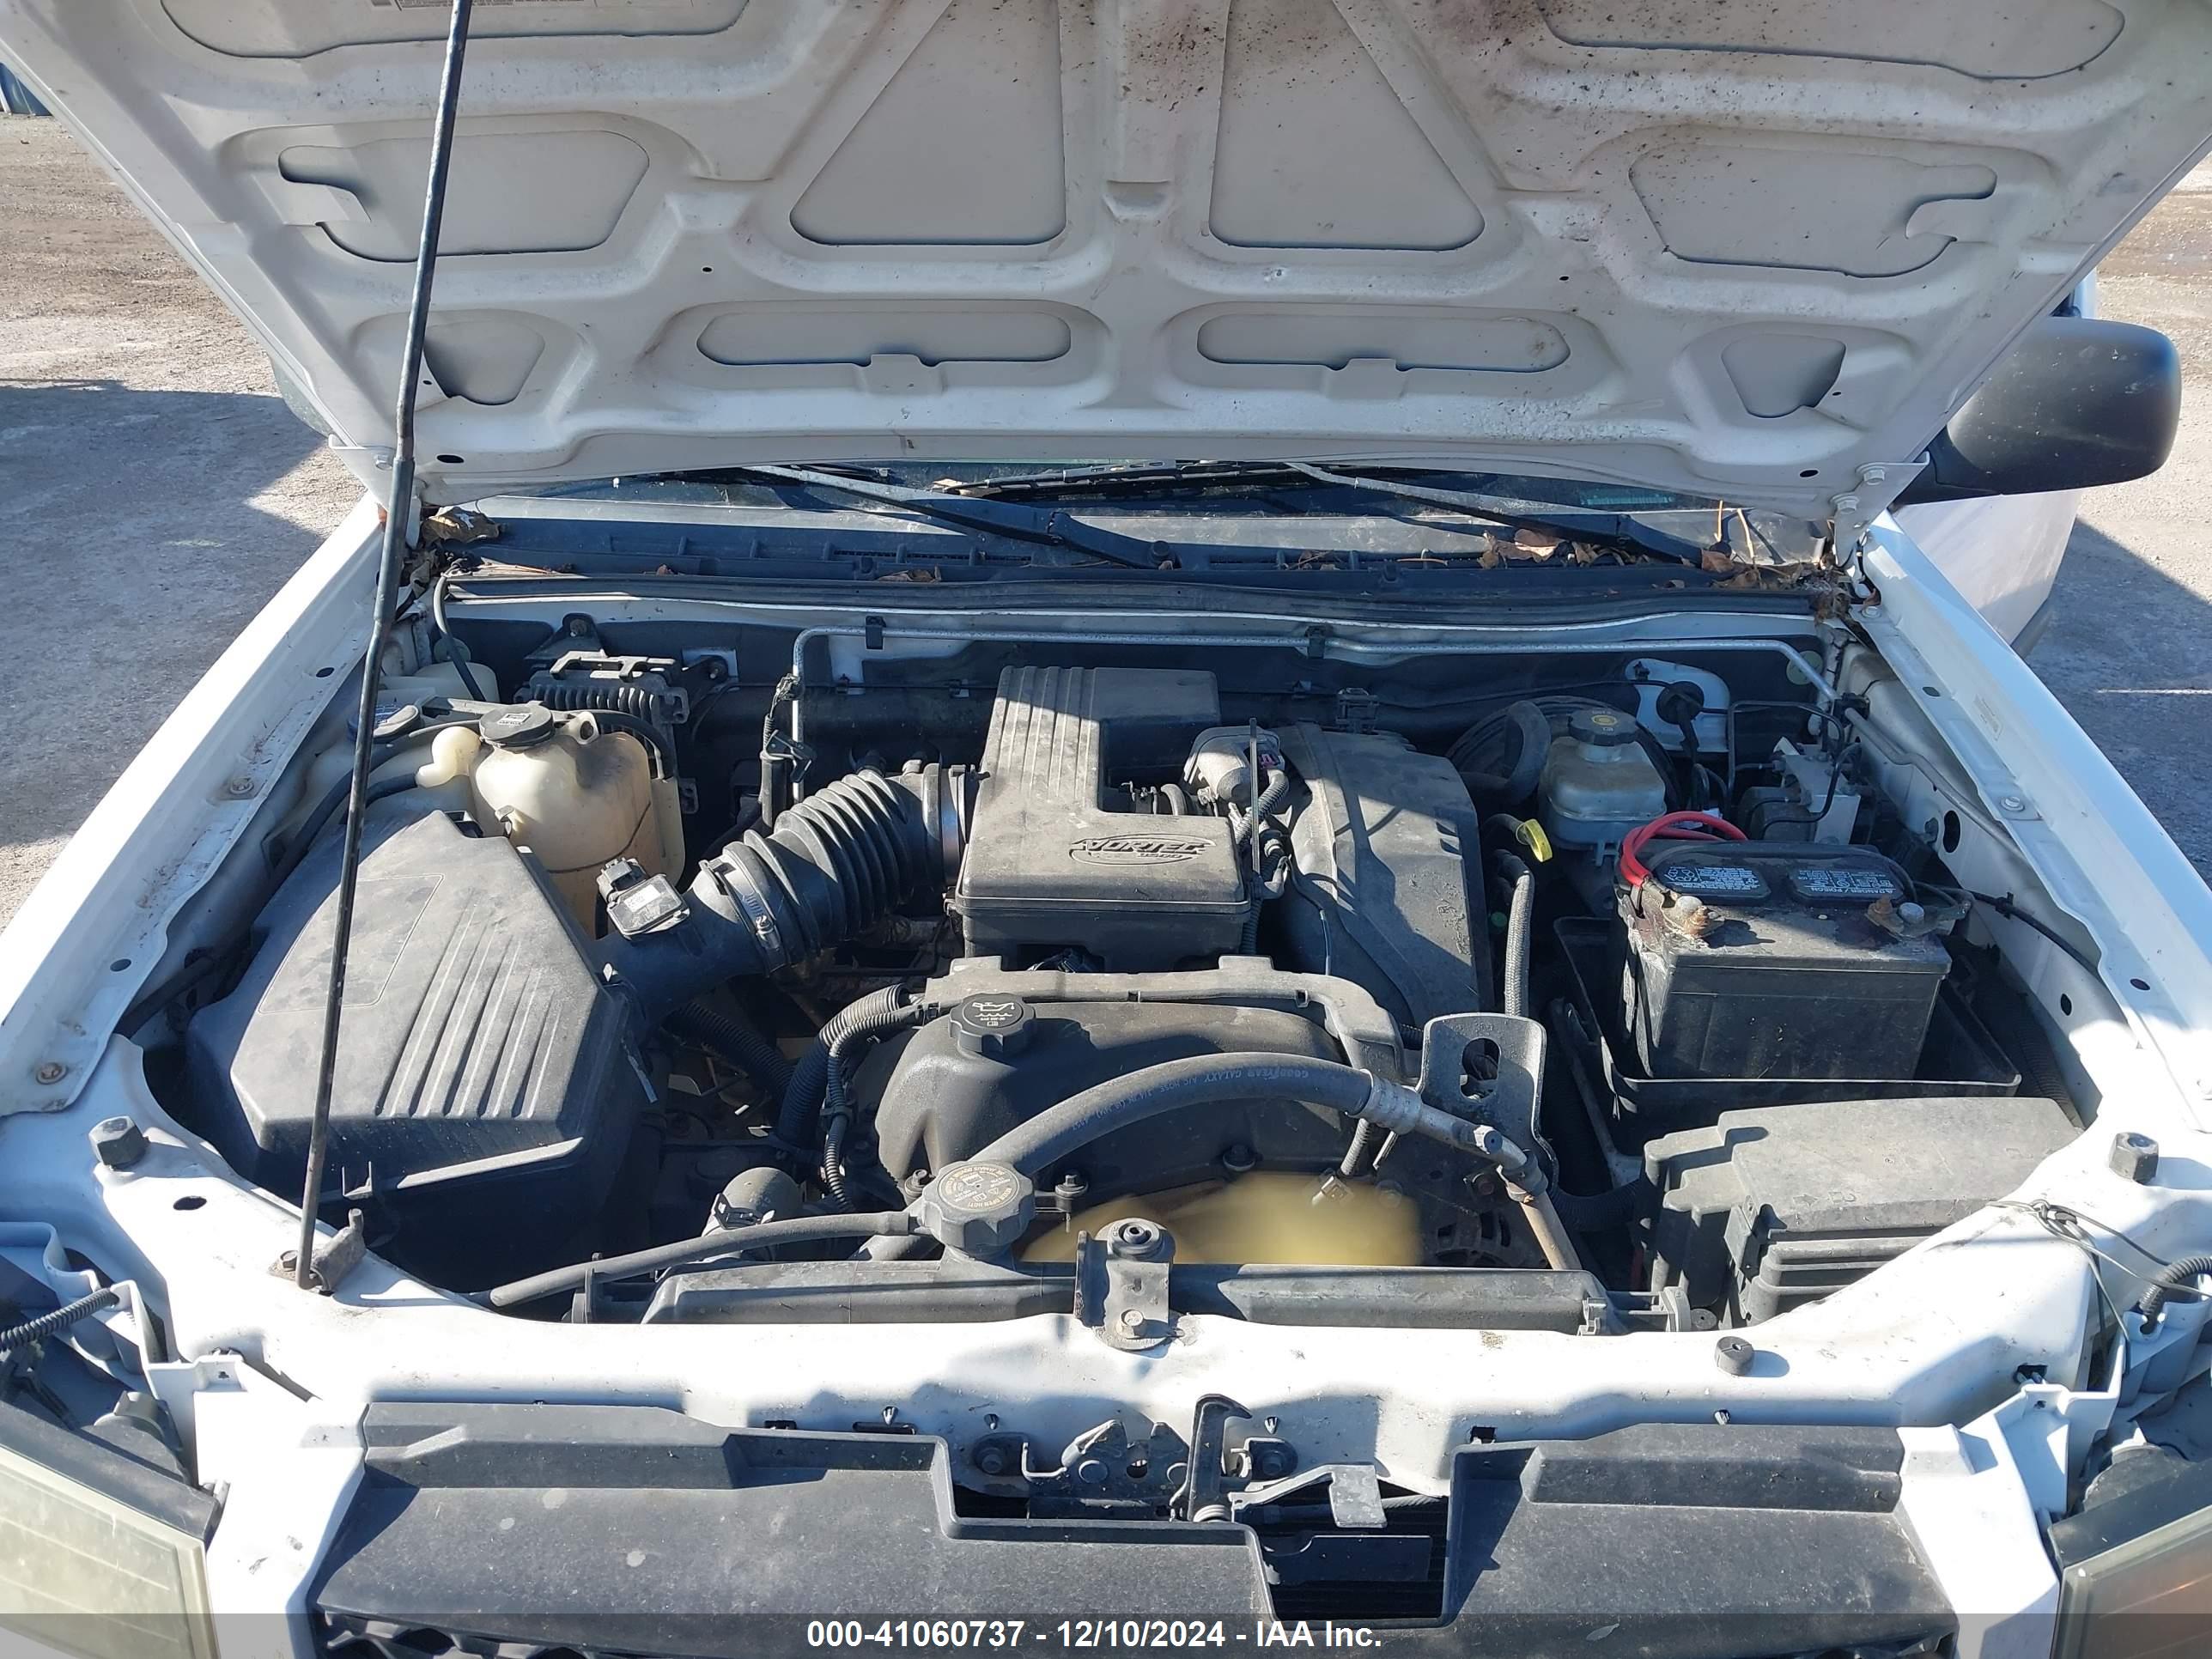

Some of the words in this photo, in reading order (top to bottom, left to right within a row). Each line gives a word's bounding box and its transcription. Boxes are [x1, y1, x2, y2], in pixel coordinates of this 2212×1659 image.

[1085, 838, 1206, 854] VORTEC
[1203, 1069, 1243, 1083] GALAXY
[1247, 1066, 1310, 1079] GOODYEAR
